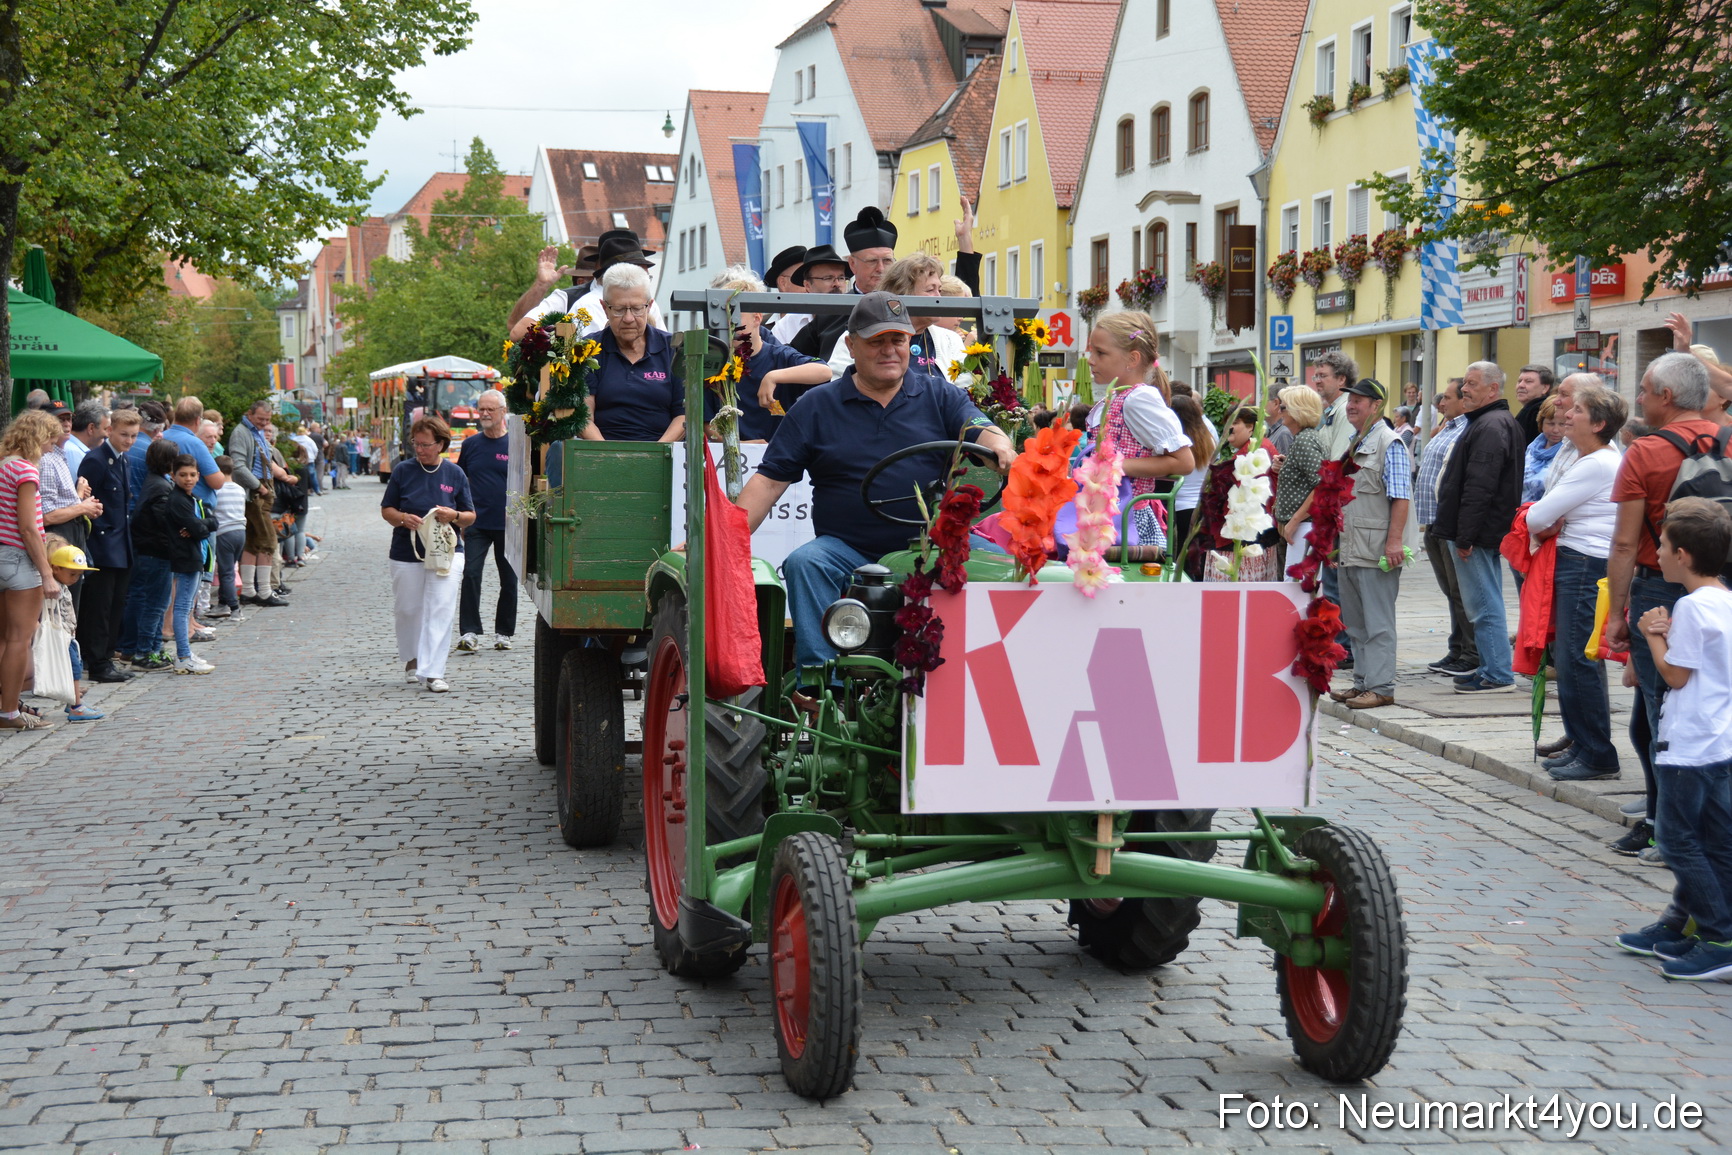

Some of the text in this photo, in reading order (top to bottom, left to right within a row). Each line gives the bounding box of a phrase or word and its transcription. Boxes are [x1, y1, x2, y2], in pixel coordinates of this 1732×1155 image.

[919, 236, 941, 256] HOTEL
[1467, 285, 1504, 302] RIALTO KINO
[1516, 257, 1526, 322] KINO
[1275, 320, 1289, 347] P
[643, 371, 667, 379] KAB
[923, 589, 1302, 802] KAB
